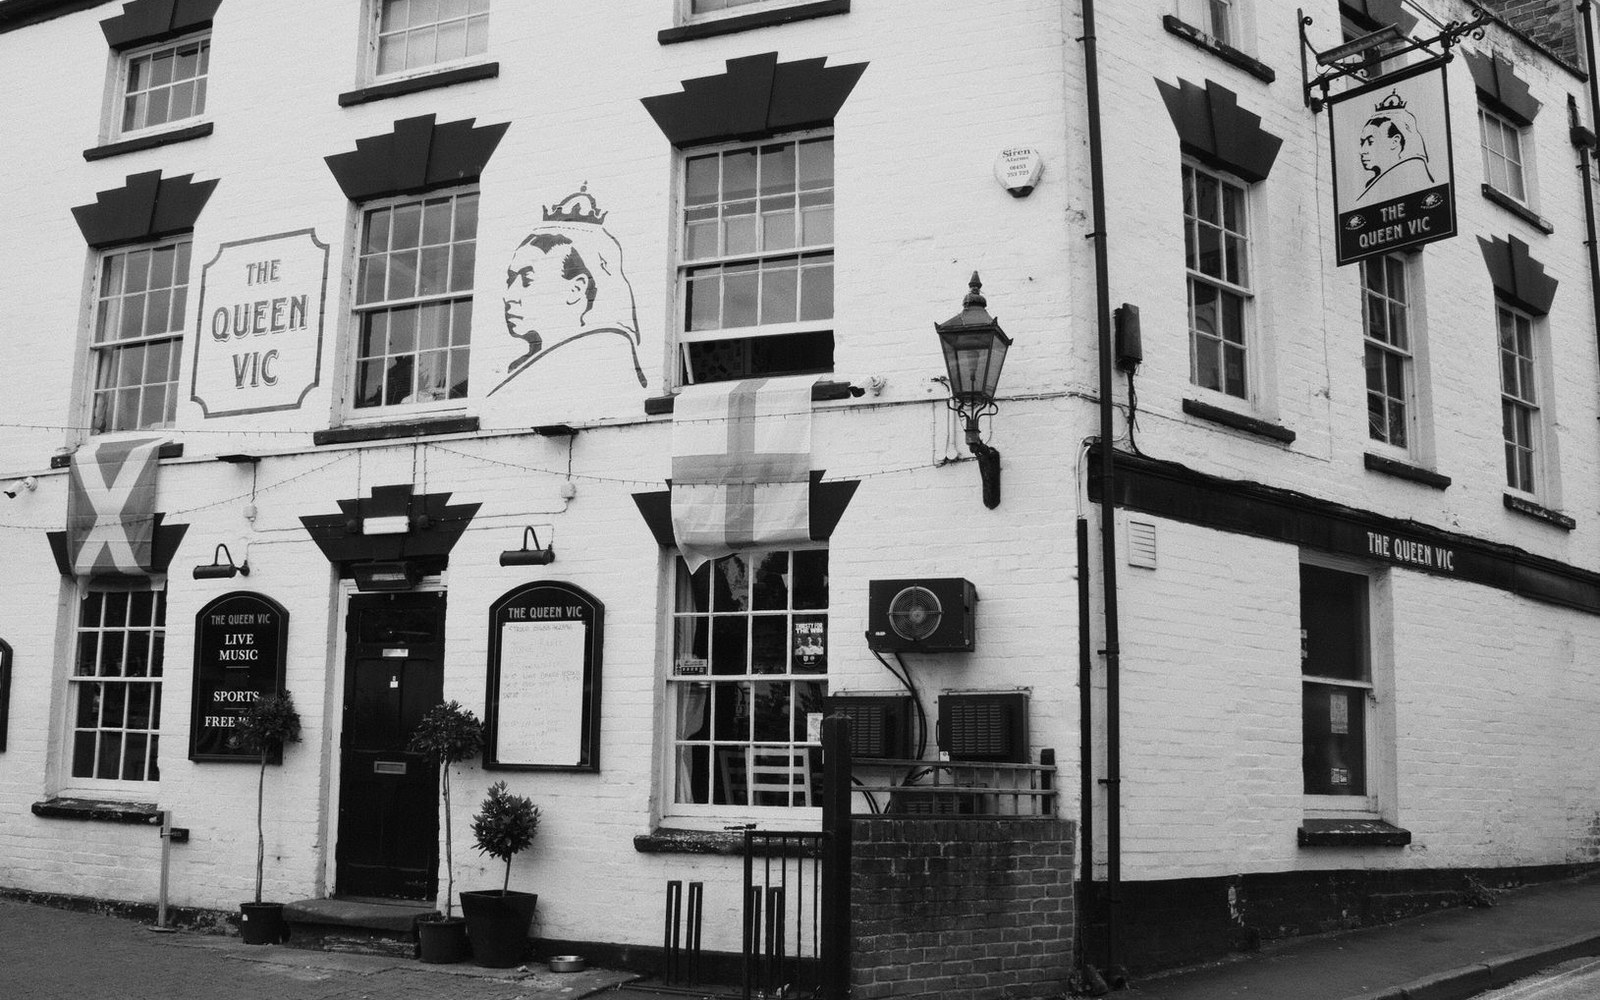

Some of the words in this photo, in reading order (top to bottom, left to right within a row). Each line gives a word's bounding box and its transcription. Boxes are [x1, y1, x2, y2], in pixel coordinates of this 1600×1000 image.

[1002, 149, 1030, 158] Siren
[1380, 203, 1406, 222] THE
[1359, 224, 1402, 248] QUEEN
[1407, 216, 1431, 235] VIC
[246, 259, 281, 286] THE
[212, 294, 309, 342] QUEEN
[232, 349, 279, 389] VIC
[1367, 532, 1391, 557] THE
[1394, 538, 1432, 566] QUEEN
[1435, 547, 1454, 571] VIC
[211, 615, 225, 625] THE
[228, 614, 255, 625] QUEEN
[257, 613, 271, 624] VIC
[508, 607, 526, 619] THE
[529, 607, 562, 619] QUEEN
[566, 606, 582, 617] VIC
[225, 634, 254, 645] LIVE
[219, 649, 258, 661] MUSIC
[213, 691, 260, 702] SPORTS
[204, 716, 235, 727] FREE
